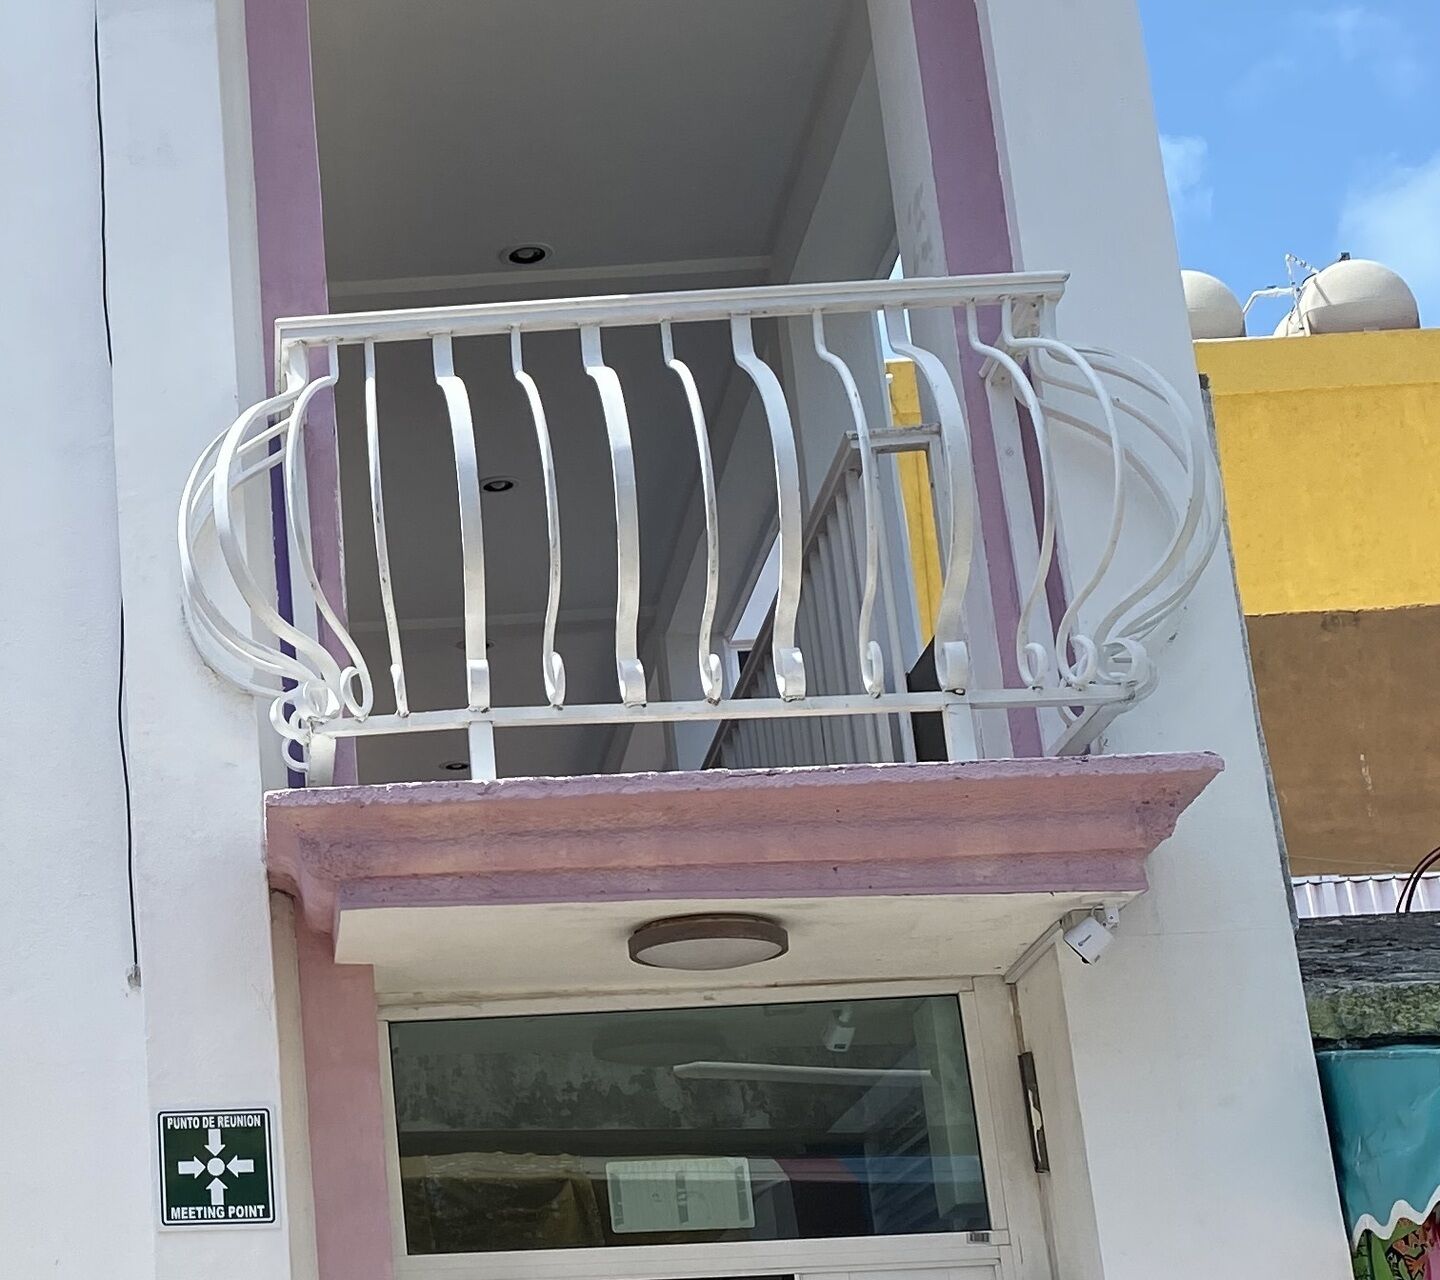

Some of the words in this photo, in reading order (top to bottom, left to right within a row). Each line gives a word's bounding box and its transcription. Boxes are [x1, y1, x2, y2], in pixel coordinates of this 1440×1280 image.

[167, 1116, 200, 1130] PUNTO
[202, 1116, 215, 1128] DE
[217, 1114, 261, 1128] REUNION
[170, 1206, 225, 1220] MEETING
[228, 1204, 266, 1218] POINT
